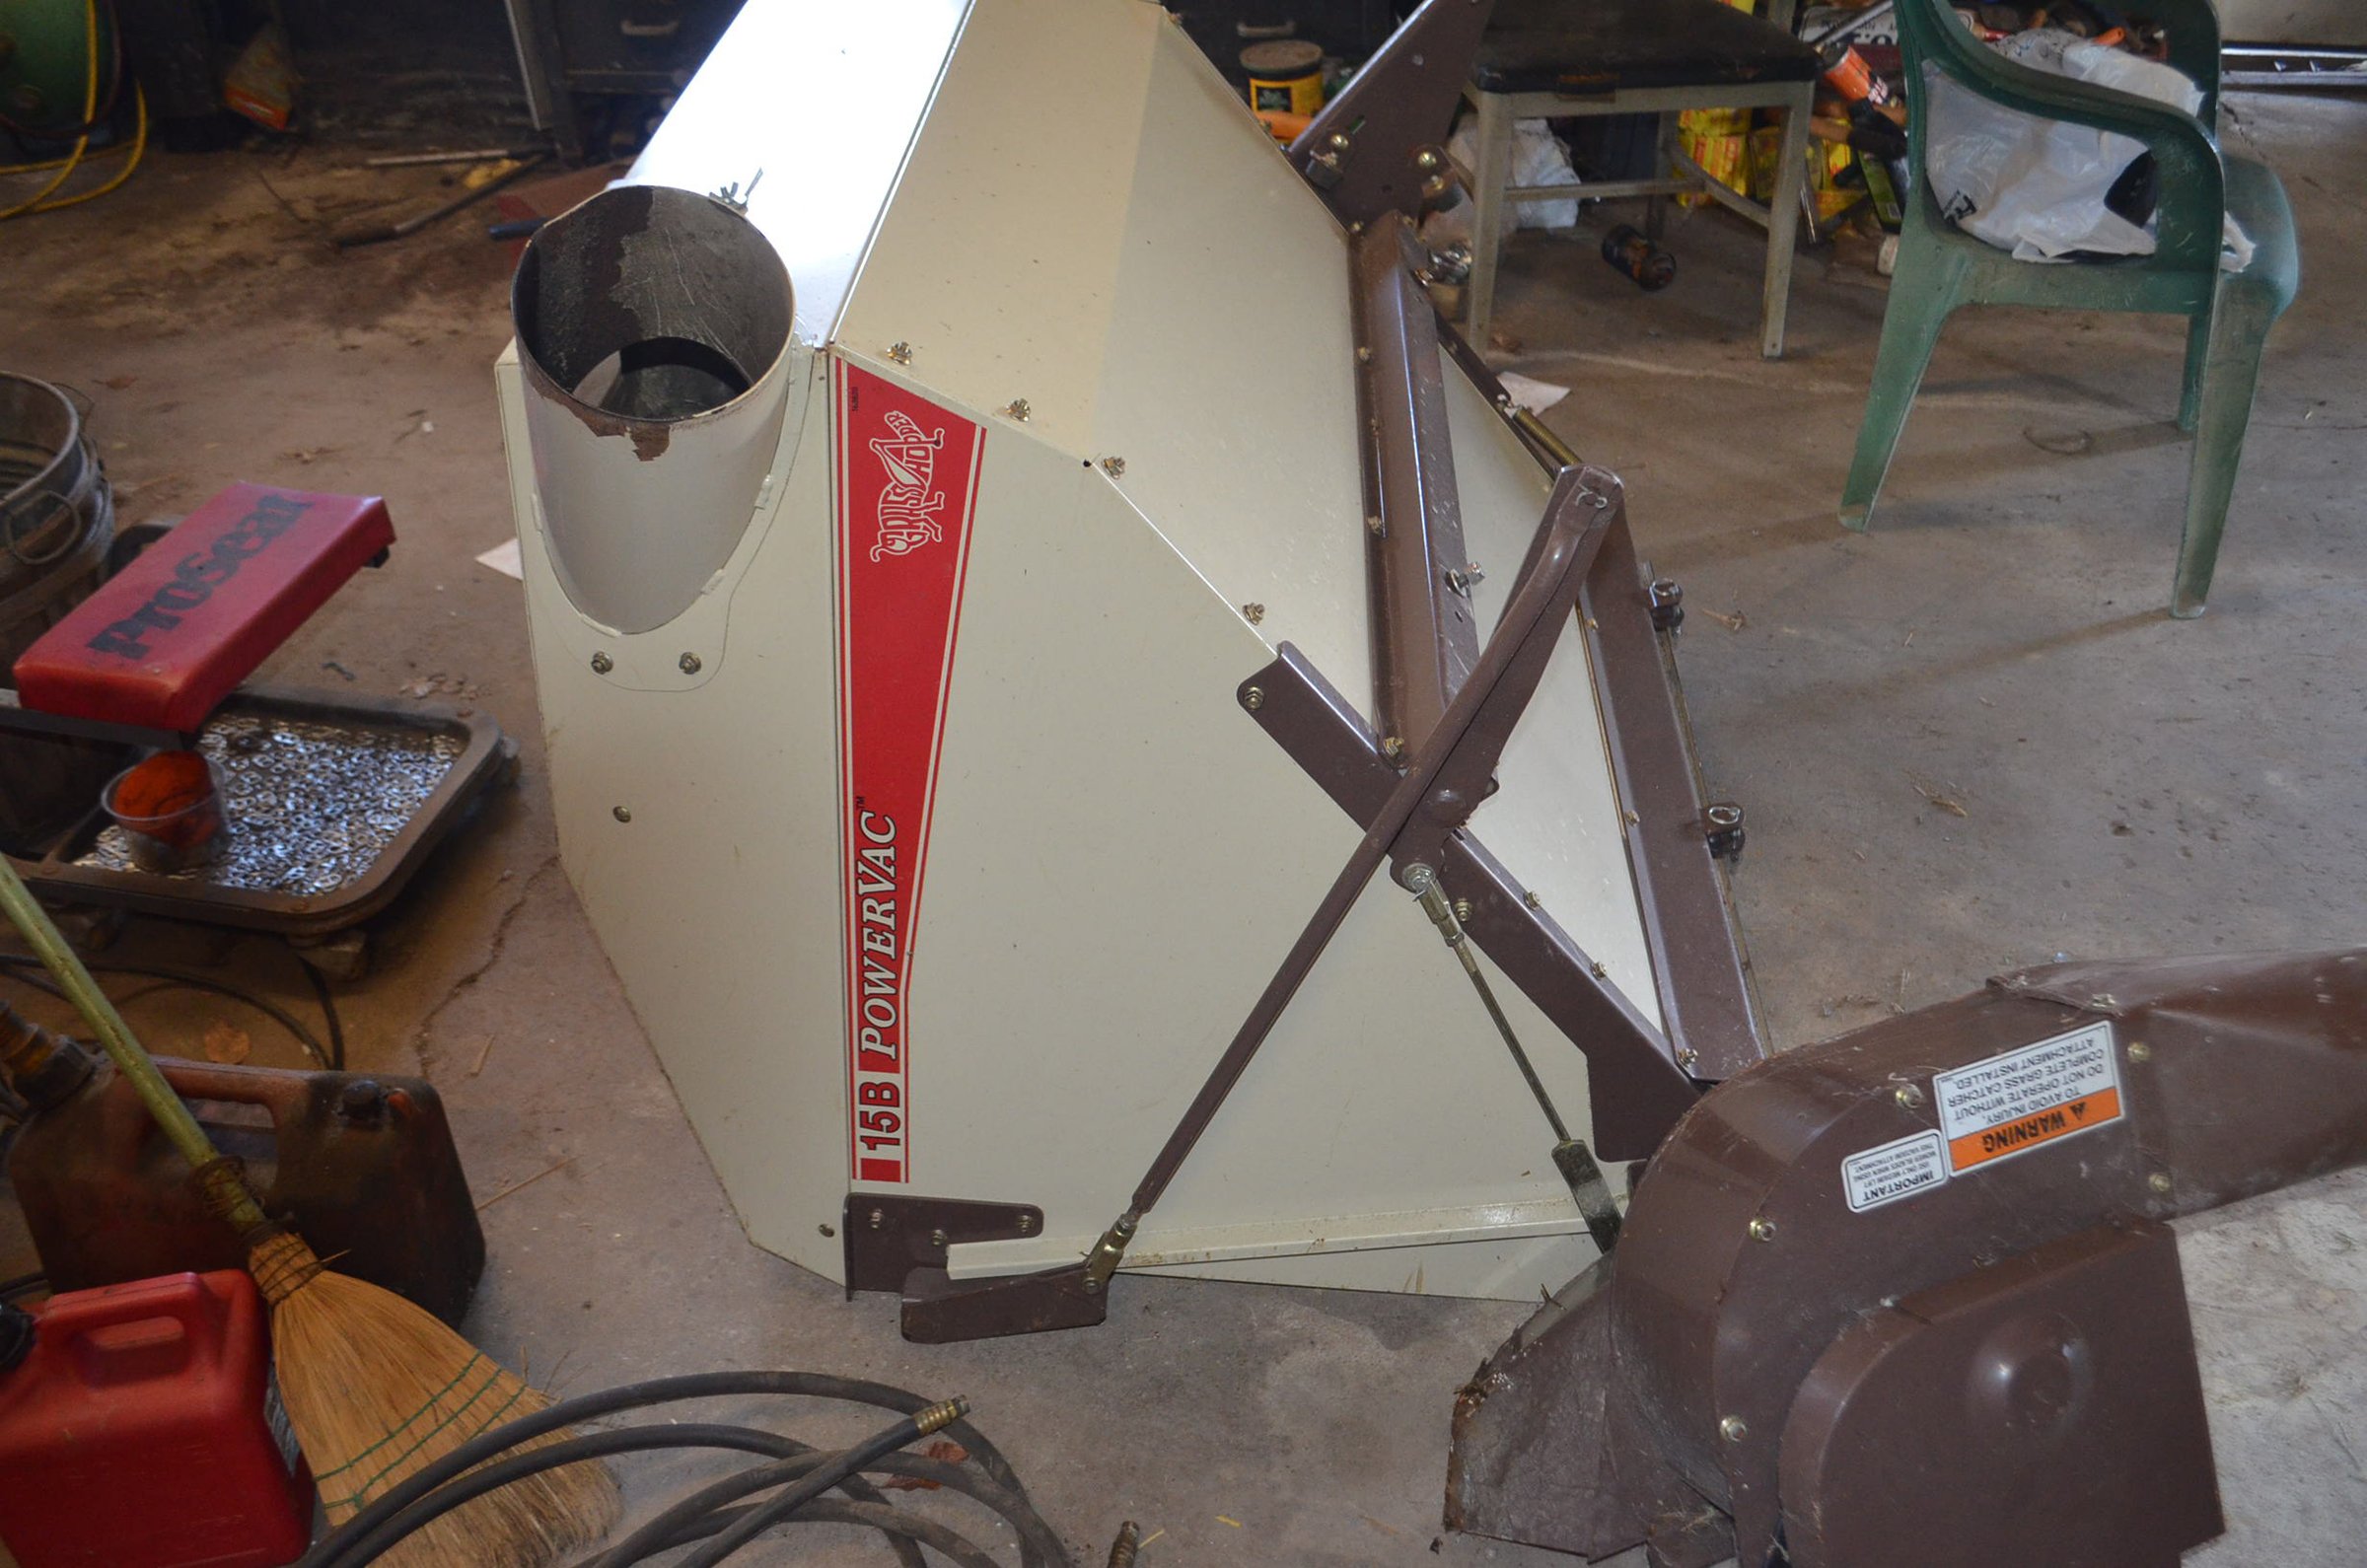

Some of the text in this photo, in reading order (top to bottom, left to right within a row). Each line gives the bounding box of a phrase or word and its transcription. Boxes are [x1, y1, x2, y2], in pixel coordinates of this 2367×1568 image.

[857, 810, 897, 1061] POWERVAC
[1946, 1047, 2105, 1108] COMPLETE GRASS CATCHER
[1952, 1061, 2104, 1121] DO NOT OPERATE WITHOUT
[1955, 1037, 2094, 1091] ATTACHMENT INSTALLED.
[859, 1081, 900, 1150] 15B
[1981, 1084, 2080, 1126] TO AVOID INJURY,
[1981, 1111, 2065, 1153] WARNING
[1864, 1172, 1934, 1201] IMPORTANT
